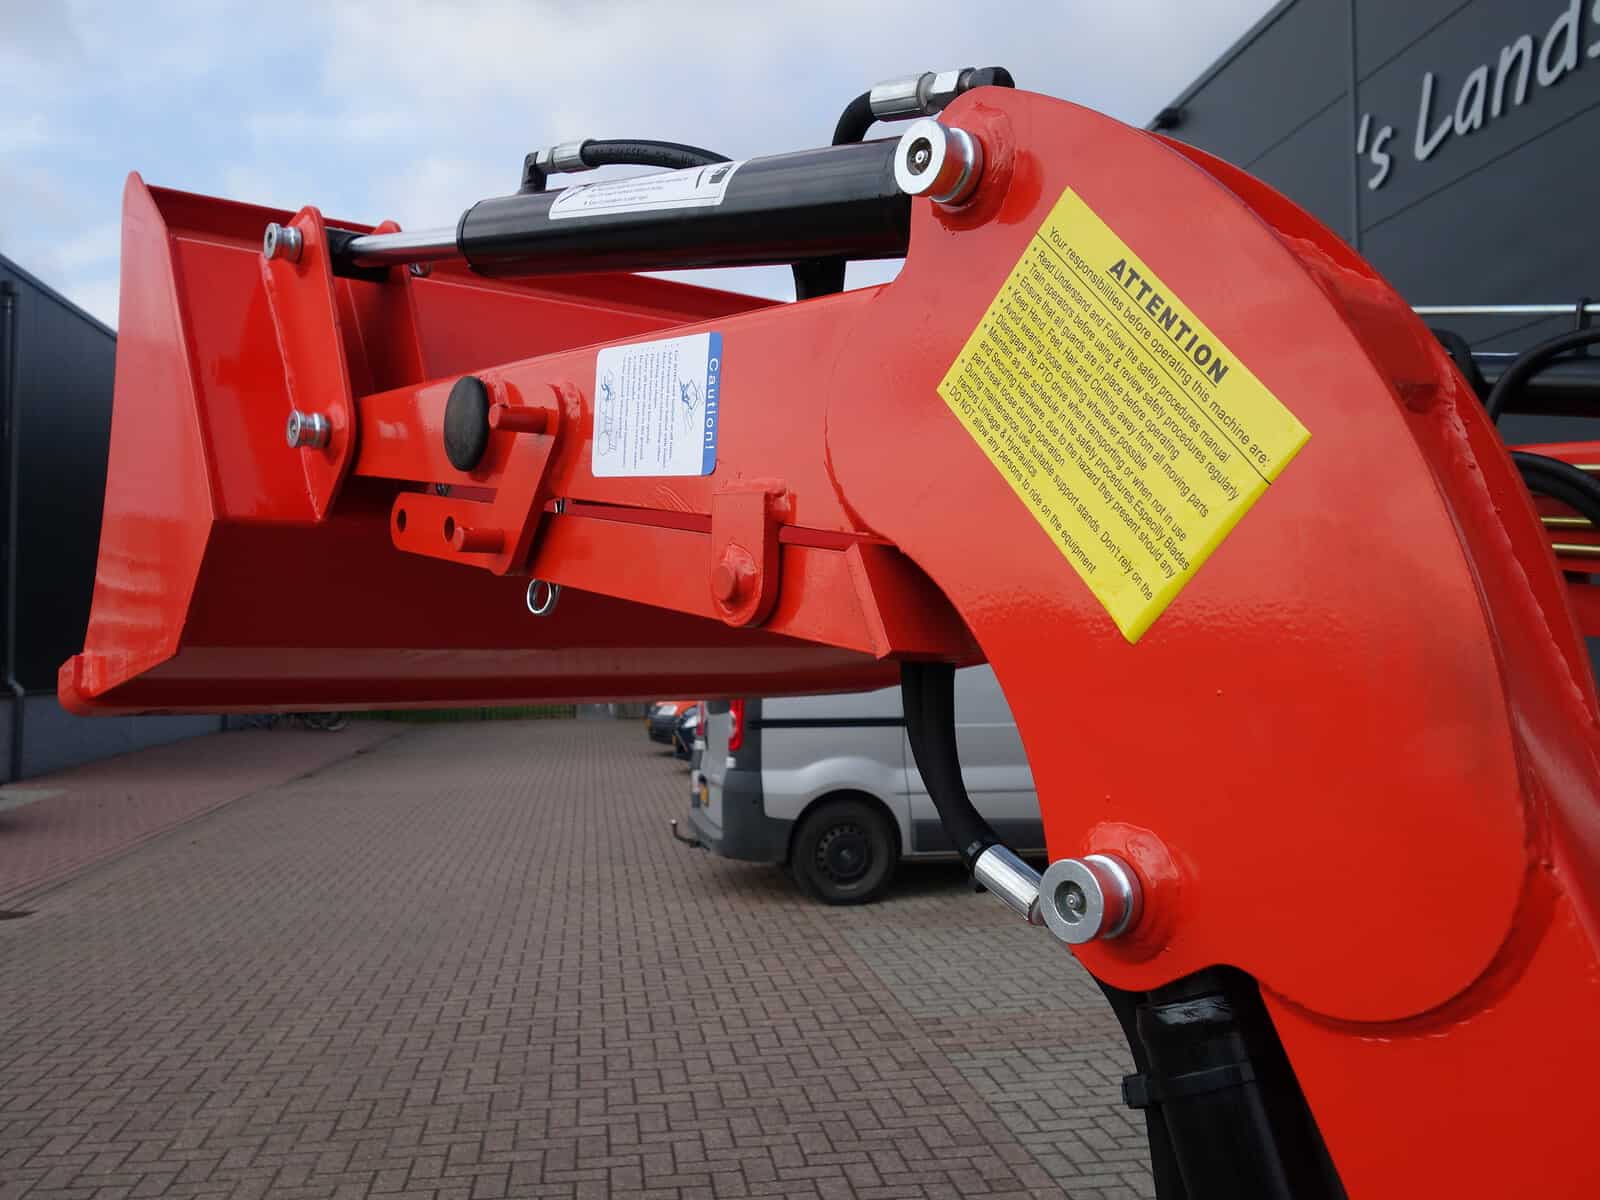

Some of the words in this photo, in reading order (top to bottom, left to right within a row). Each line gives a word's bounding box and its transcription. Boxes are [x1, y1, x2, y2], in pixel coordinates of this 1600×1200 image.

[1357, 113, 1393, 190] 's
[971, 352, 986, 369] part
[983, 364, 1002, 388] break
[1000, 384, 1017, 409] loose
[1016, 404, 1036, 434] during
[1035, 429, 1065, 467] operation
[1003, 301, 1023, 325] Avoid
[1020, 322, 1045, 355] wearing
[1044, 348, 1062, 372] loose
[1060, 369, 1087, 404] clothing
[1085, 399, 1119, 439] whenever
[1115, 436, 1147, 472] possible
[1011, 288, 1028, 314] Keep
[1062, 347, 1078, 368] Hair
[1076, 365, 1092, 383] and
[1089, 378, 1118, 417] Clothing
[1116, 411, 1137, 438] away
[1135, 430, 1153, 455] from
[1152, 452, 1164, 466] all
[1161, 463, 1189, 498] moving
[1186, 494, 1209, 518] parts
[1020, 275, 1043, 305] Ensure
[1041, 299, 1057, 319] that
[1054, 316, 1065, 329] all
[1060, 325, 1083, 351] guards
[1084, 350, 1097, 367] are
[1096, 362, 1104, 375] in
[1101, 372, 1123, 396] place
[1122, 391, 1146, 421] before
[1144, 419, 1180, 462] operating
[1028, 262, 1046, 286] Train
[1044, 282, 1075, 318] operators
[1073, 312, 1095, 341] before
[1094, 338, 1114, 364] using
[1112, 357, 1122, 369] &
[1119, 366, 1143, 395] review
[1142, 391, 1165, 422] safety
[1162, 416, 1206, 465] procedures
[1204, 461, 1239, 503] regularly
[1048, 226, 1067, 250] Your
[1066, 247, 1124, 311] responsibilities
[1123, 306, 1152, 340] before
[1150, 337, 1192, 386] operating
[1191, 379, 1210, 403] this
[1209, 401, 1250, 445] machine
[1089, 309, 1105, 327] and
[1102, 322, 1126, 351] Follow
[1125, 346, 1138, 364] the
[1136, 361, 1160, 391] safety
[1156, 385, 1201, 433] procedures
[1198, 430, 1230, 464] manual
[1108, 257, 1230, 385] ATTENTION
[949, 385, 962, 402] DO
[959, 398, 975, 419] NOT
[972, 417, 989, 438] allow
[987, 436, 999, 454] any
[997, 450, 1023, 482] persons
[1021, 478, 1030, 491] to
[1028, 489, 1041, 506] ride
[1040, 504, 1051, 518] on
[1049, 514, 1062, 532] the
[1060, 530, 1096, 575] equipment
[957, 373, 979, 405] tractors
[978, 400, 1001, 432] Linkage
[999, 428, 1008, 439] &
[1005, 435, 1037, 478] Hydraulics
[964, 362, 984, 391] During
[1029, 445, 1054, 476] suitable
[1052, 474, 1079, 506] support
[1099, 531, 1121, 558] Don't
[1117, 556, 1132, 577] rely
[1130, 572, 1142, 586] on
[1140, 582, 1153, 601] the
[980, 340, 994, 356] and
[991, 351, 1017, 388] Securing
[1045, 418, 1059, 437] due
[1057, 432, 1066, 446] to
[1064, 441, 1077, 459] the
[1075, 454, 1101, 486] hazard
[1097, 481, 1114, 506] they
[1110, 501, 1141, 535] present
[1137, 532, 1163, 562] should
[1160, 560, 1175, 581] any
[988, 326, 1013, 359] Maintain
[1011, 356, 1021, 369] as
[1018, 366, 1032, 382] per
[1030, 379, 1059, 415] schedule
[1057, 410, 1066, 423] in
[1065, 418, 1077, 436] the
[1075, 433, 1097, 462] safety
[1163, 537, 1190, 571] Blades
[996, 313, 1027, 354] Disengage
[1026, 349, 1037, 366] the
[1036, 361, 1054, 384] PTO
[1051, 379, 1068, 402] drive
[1067, 400, 1086, 423] when
[1084, 418, 1125, 472] transporting
[1123, 466, 1133, 479] or
[1131, 476, 1152, 502] when
[1150, 499, 1166, 516] not
[1163, 512, 1172, 526] in
[1170, 523, 1186, 542] use
